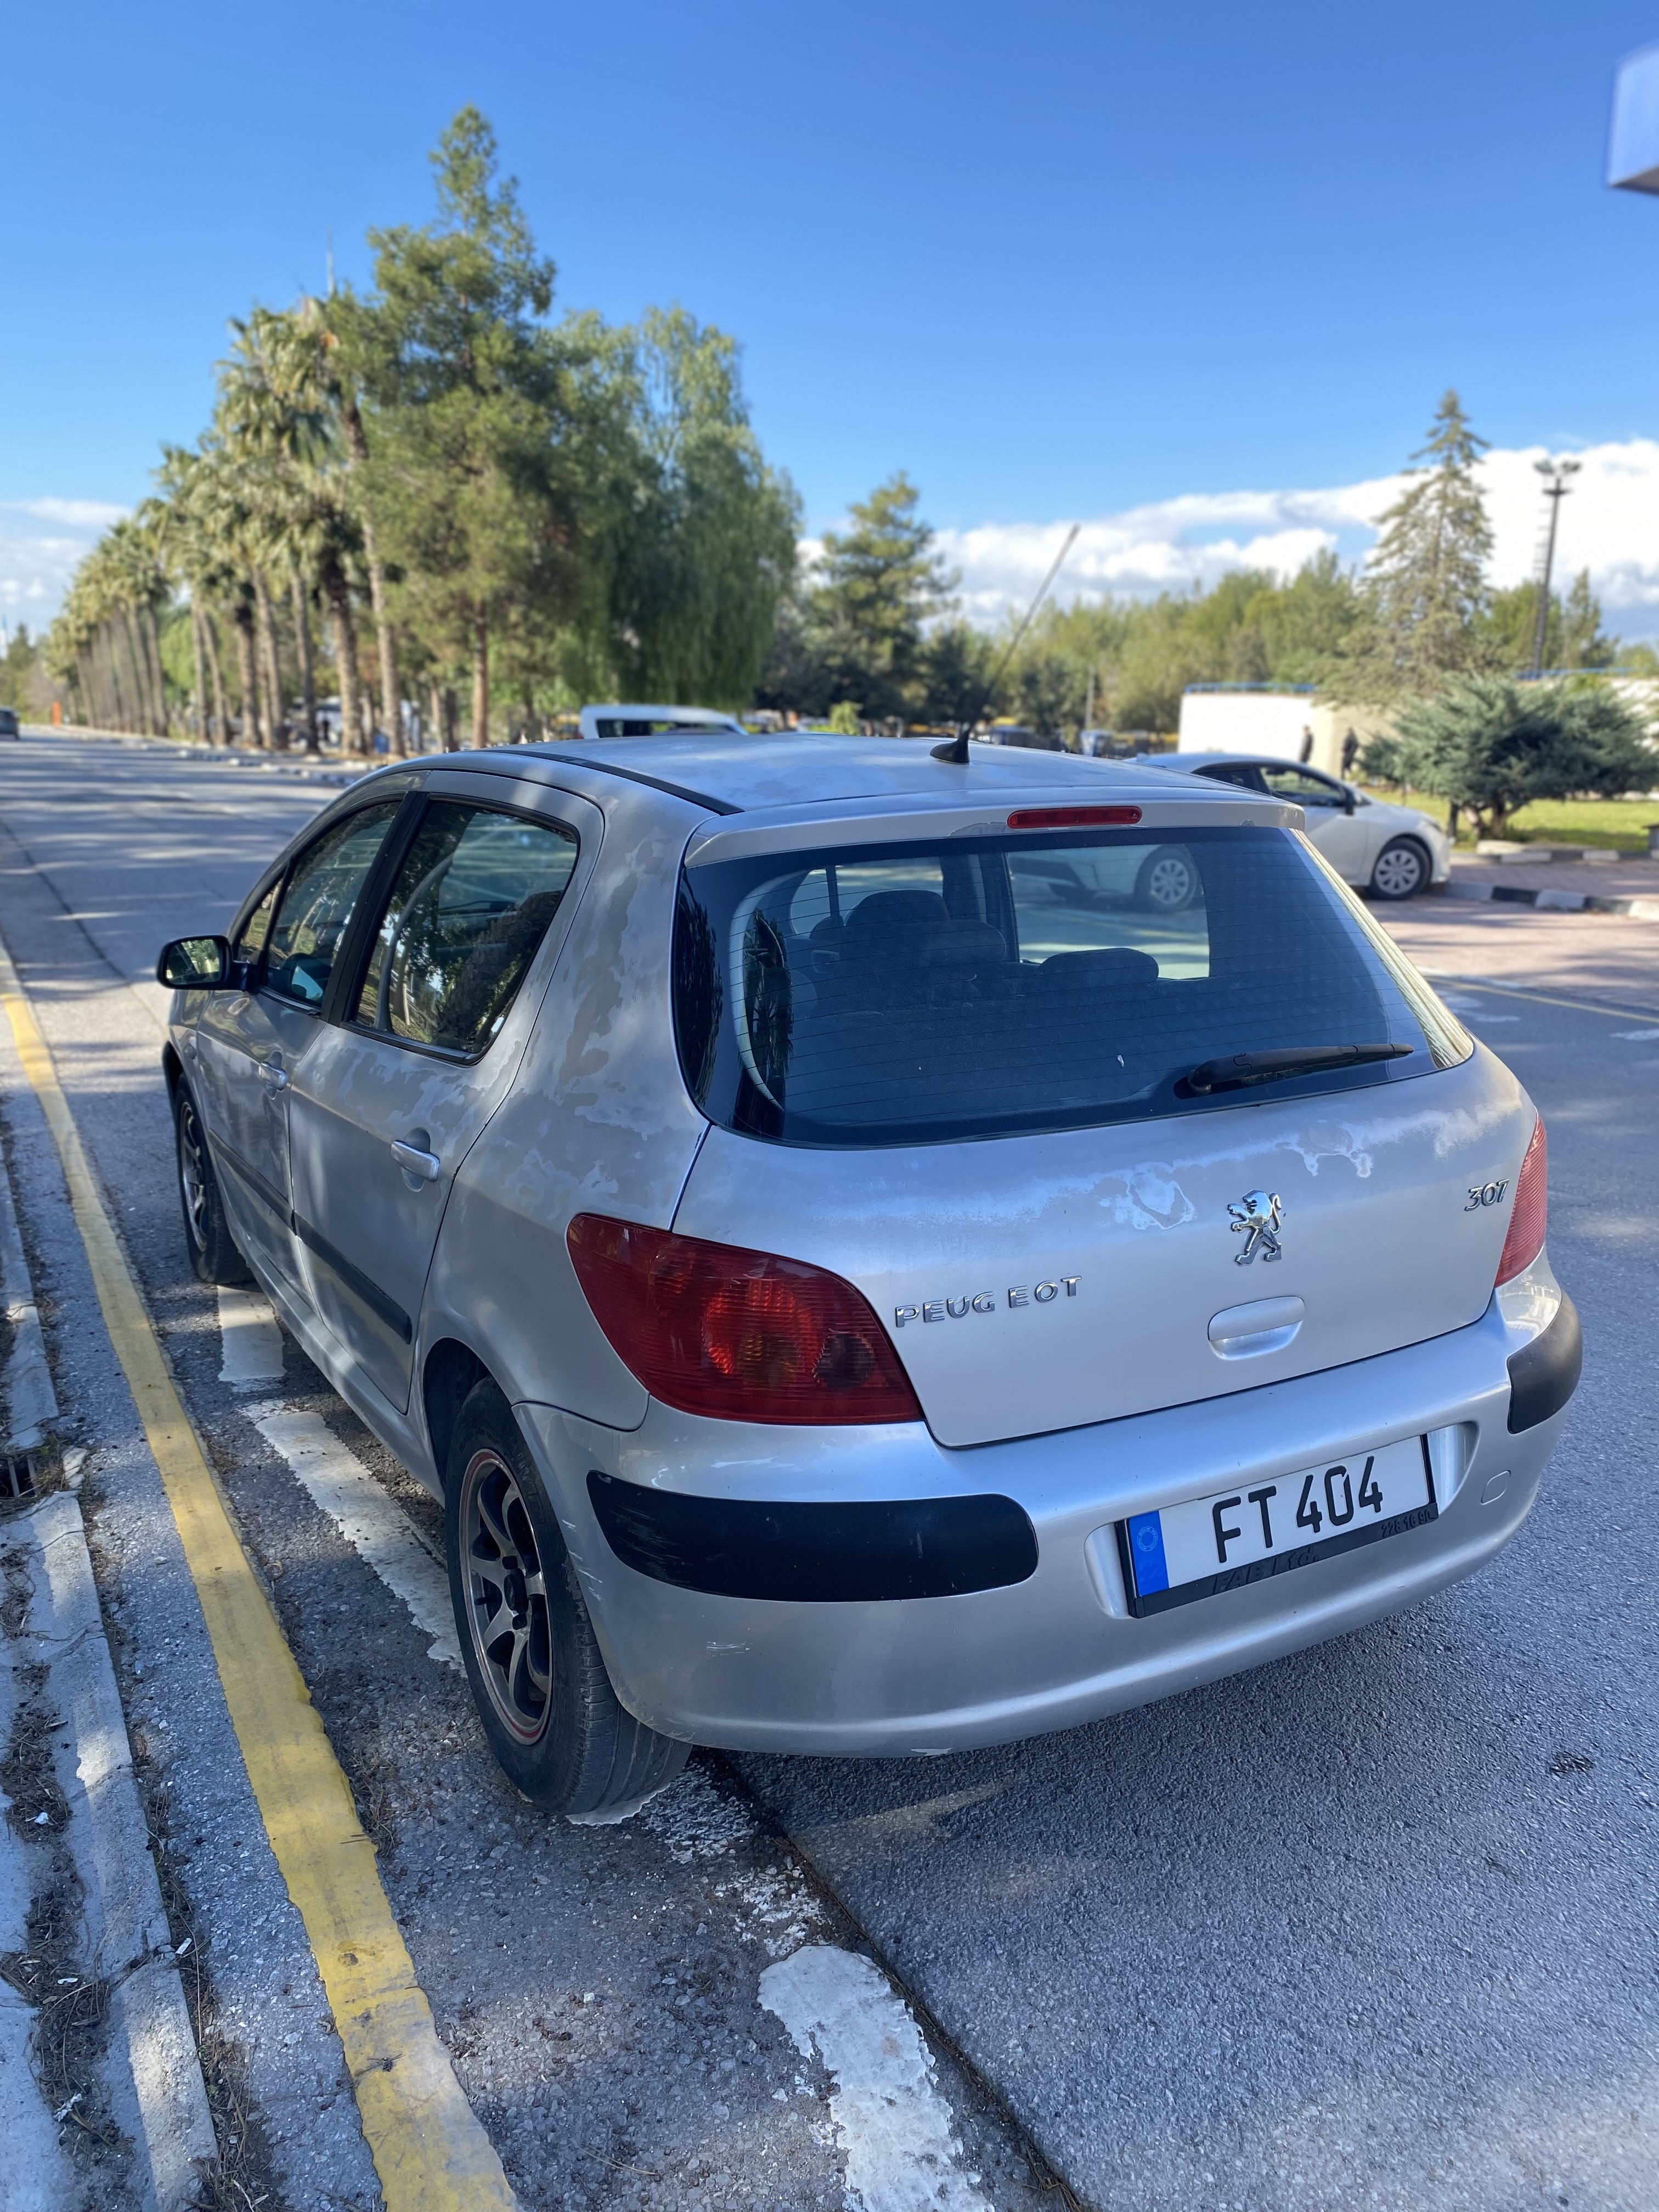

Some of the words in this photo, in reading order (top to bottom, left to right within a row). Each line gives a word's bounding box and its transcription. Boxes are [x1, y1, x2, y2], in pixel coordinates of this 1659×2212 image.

[1464, 1178, 1510, 1211] 307
[895, 1275, 1082, 1328] PEUGEOT
[1212, 1485, 1277, 1564] FT
[1295, 1455, 1383, 1533] 404
[1213, 1565, 1265, 1595] FAB
